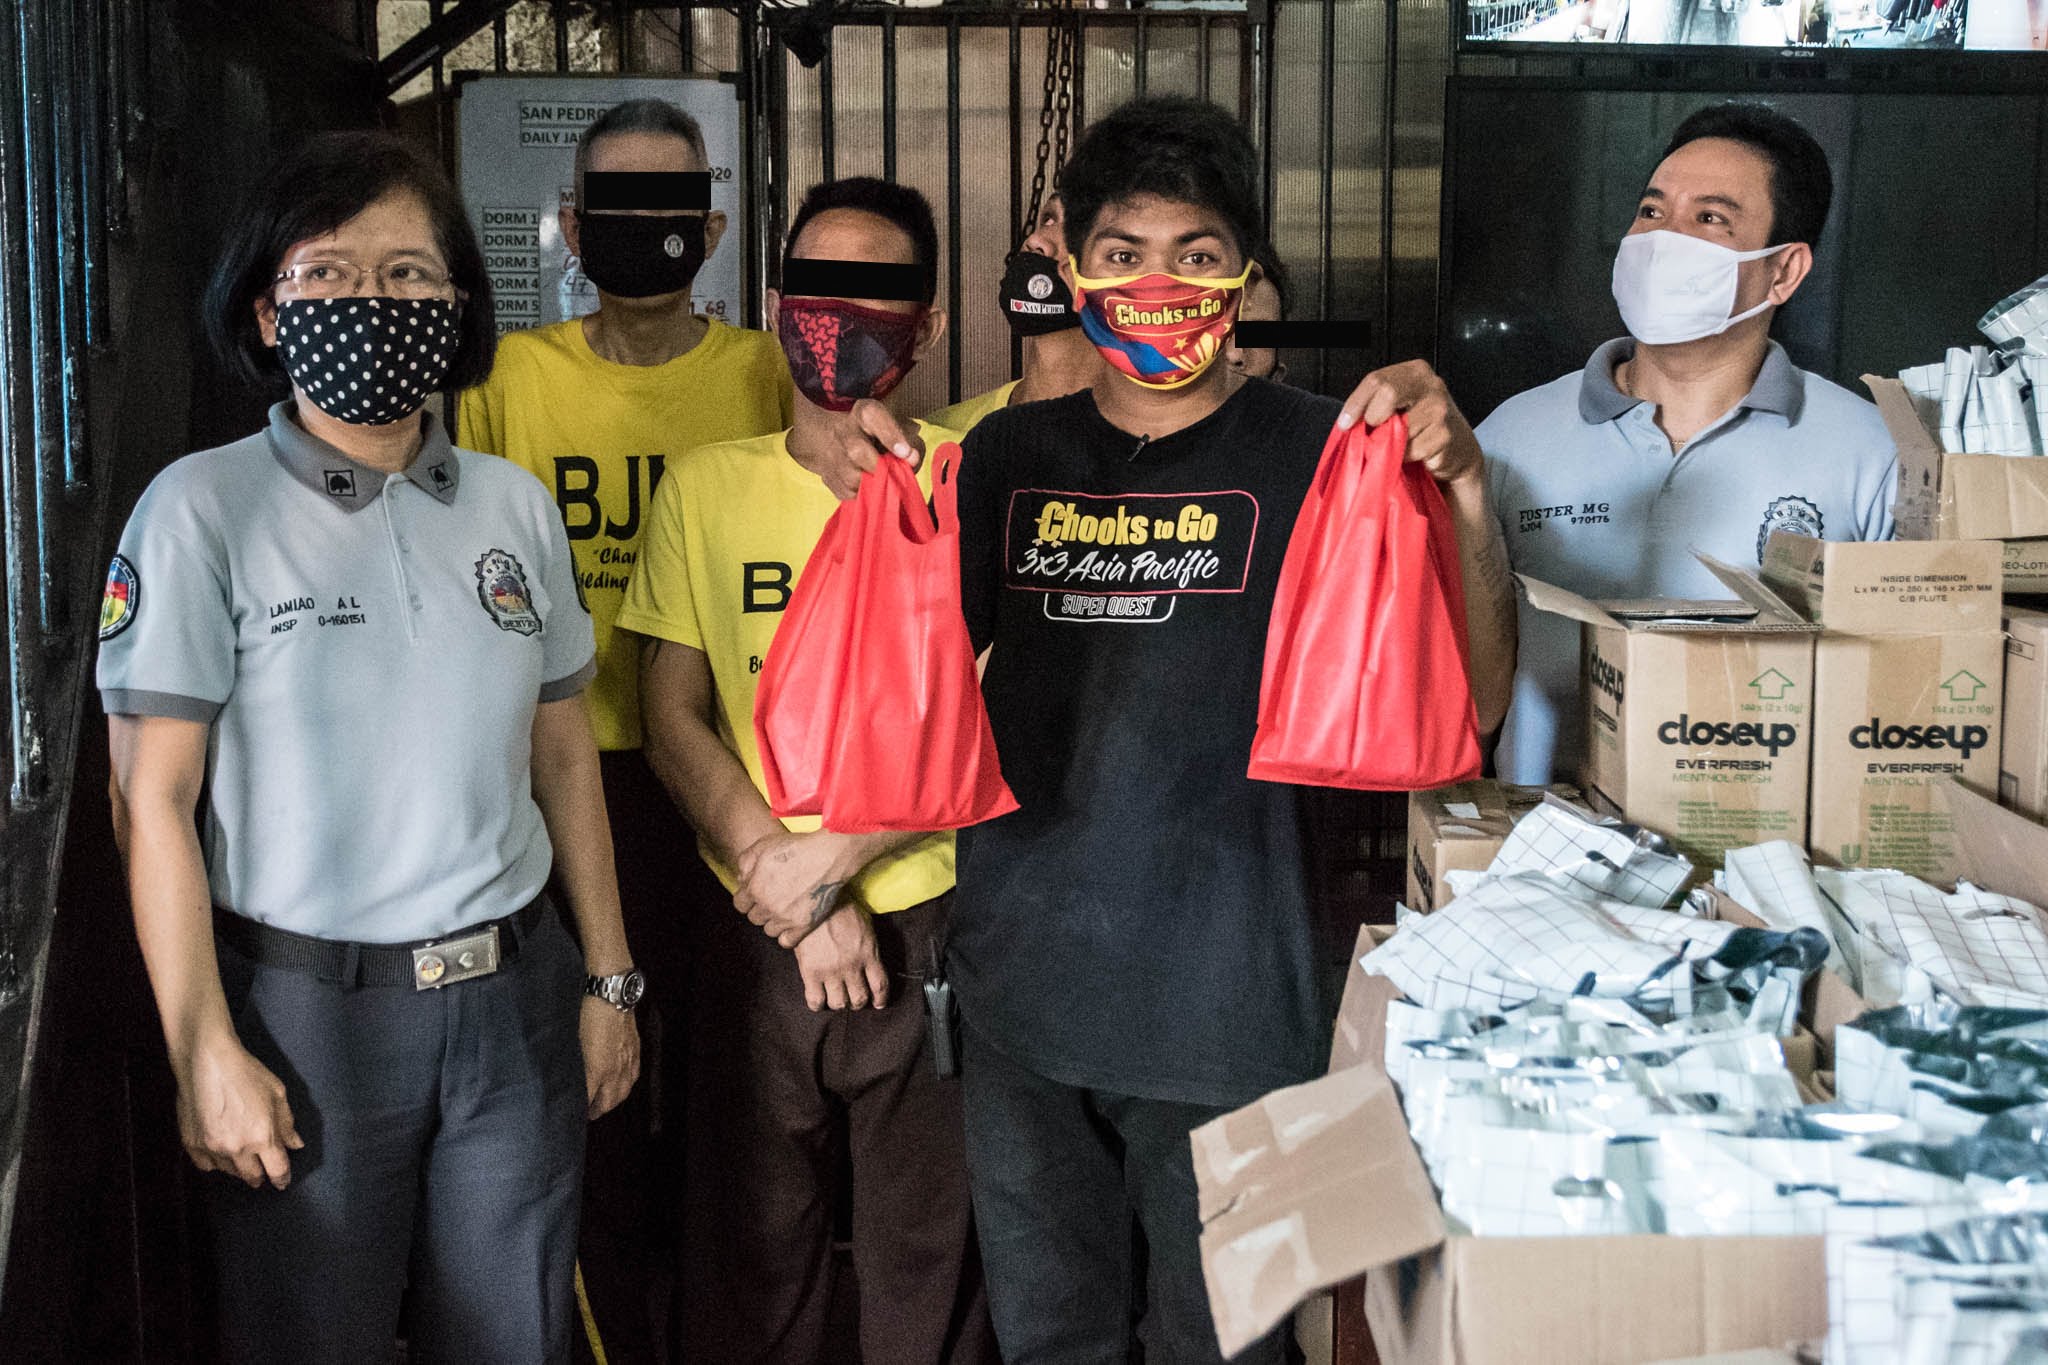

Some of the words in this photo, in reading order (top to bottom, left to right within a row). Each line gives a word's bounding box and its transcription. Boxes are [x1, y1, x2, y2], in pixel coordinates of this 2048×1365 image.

[521, 106, 553, 120] SAN
[522, 132, 560, 144] DAILY
[484, 212, 527, 225] DORM
[531, 212, 539, 225] 1
[484, 235, 527, 247] DORM
[531, 235, 539, 247] 2
[484, 257, 527, 268] DORM
[531, 257, 539, 268] 3
[531, 278, 539, 289] 4
[495, 300, 528, 311] ORM
[531, 300, 539, 311] 5
[1115, 304, 1185, 326] Chooks
[1187, 308, 1199, 319] to
[1200, 297, 1222, 317] Go
[495, 322, 528, 333] ORM
[1520, 505, 1574, 523] FOSTER
[1034, 501, 1149, 546] Chooks
[1153, 519, 1176, 539] to
[1176, 504, 1219, 542] Go
[1017, 548, 1070, 577] 3x3
[1064, 551, 1127, 583] Asia
[1129, 549, 1220, 589] Pacific
[1880, 575, 1911, 583] INSIDE
[1913, 574, 1967, 583] DIMENSION
[1854, 585, 1861, 593] L
[1918, 594, 1948, 602] FLUTE
[270, 597, 316, 619] LAMIAO
[1061, 594, 1105, 616] SUPER
[1106, 596, 1156, 616] QUEST
[271, 619, 297, 634] INSP
[1658, 713, 1797, 757] closeup
[1848, 717, 1989, 759] closeup
[1675, 759, 1772, 771] EVERFRESH
[1867, 763, 1964, 773] EVERFRESH
[1672, 773, 1730, 784] MENTHOL
[1864, 776, 1921, 787] MENTHOL
